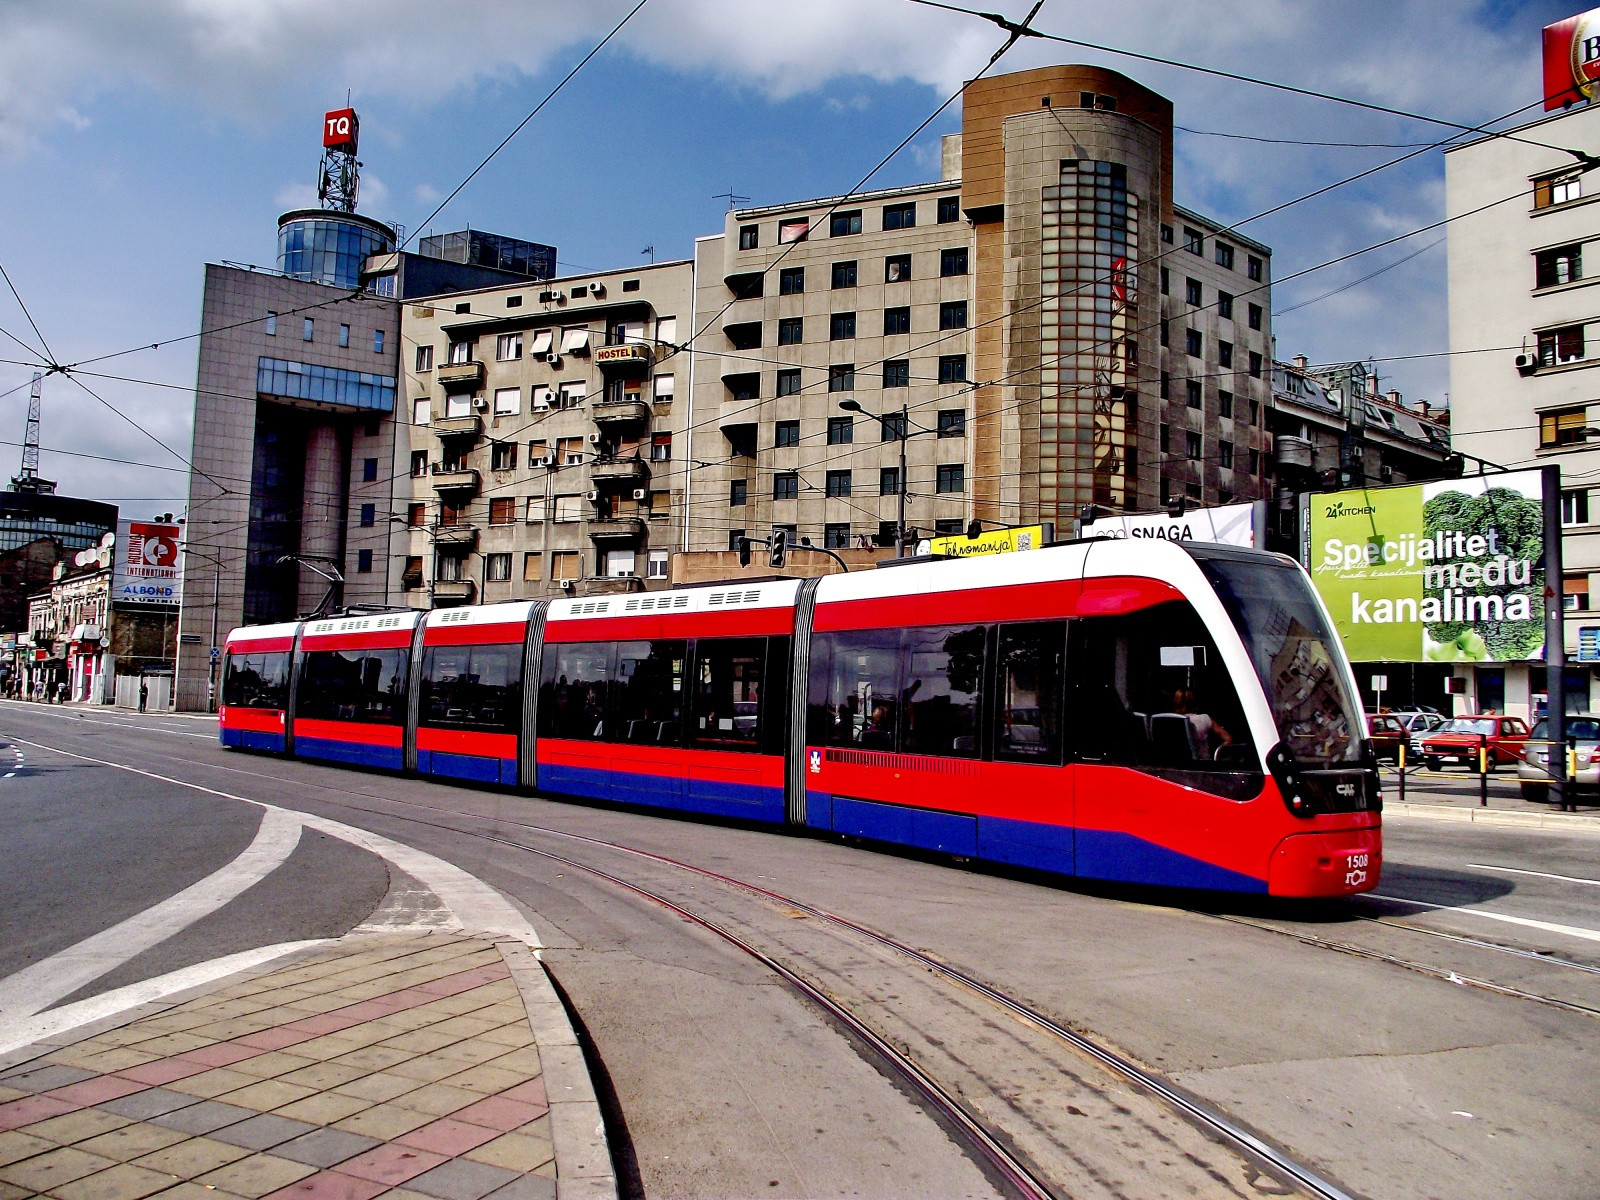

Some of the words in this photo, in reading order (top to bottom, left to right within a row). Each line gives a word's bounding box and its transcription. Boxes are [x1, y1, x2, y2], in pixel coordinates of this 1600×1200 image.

[327, 117, 349, 136] TQ
[598, 349, 630, 360] HOSTEL
[1131, 524, 1193, 540] SNAGA
[128, 534, 142, 565] HOLDING
[1324, 528, 1500, 570] Specijalitet
[127, 567, 176, 578] INTERNATIONAL
[123, 586, 173, 596] ALBOND
[1352, 588, 1531, 624] kanalima
[1346, 854, 1368, 868] 1508
